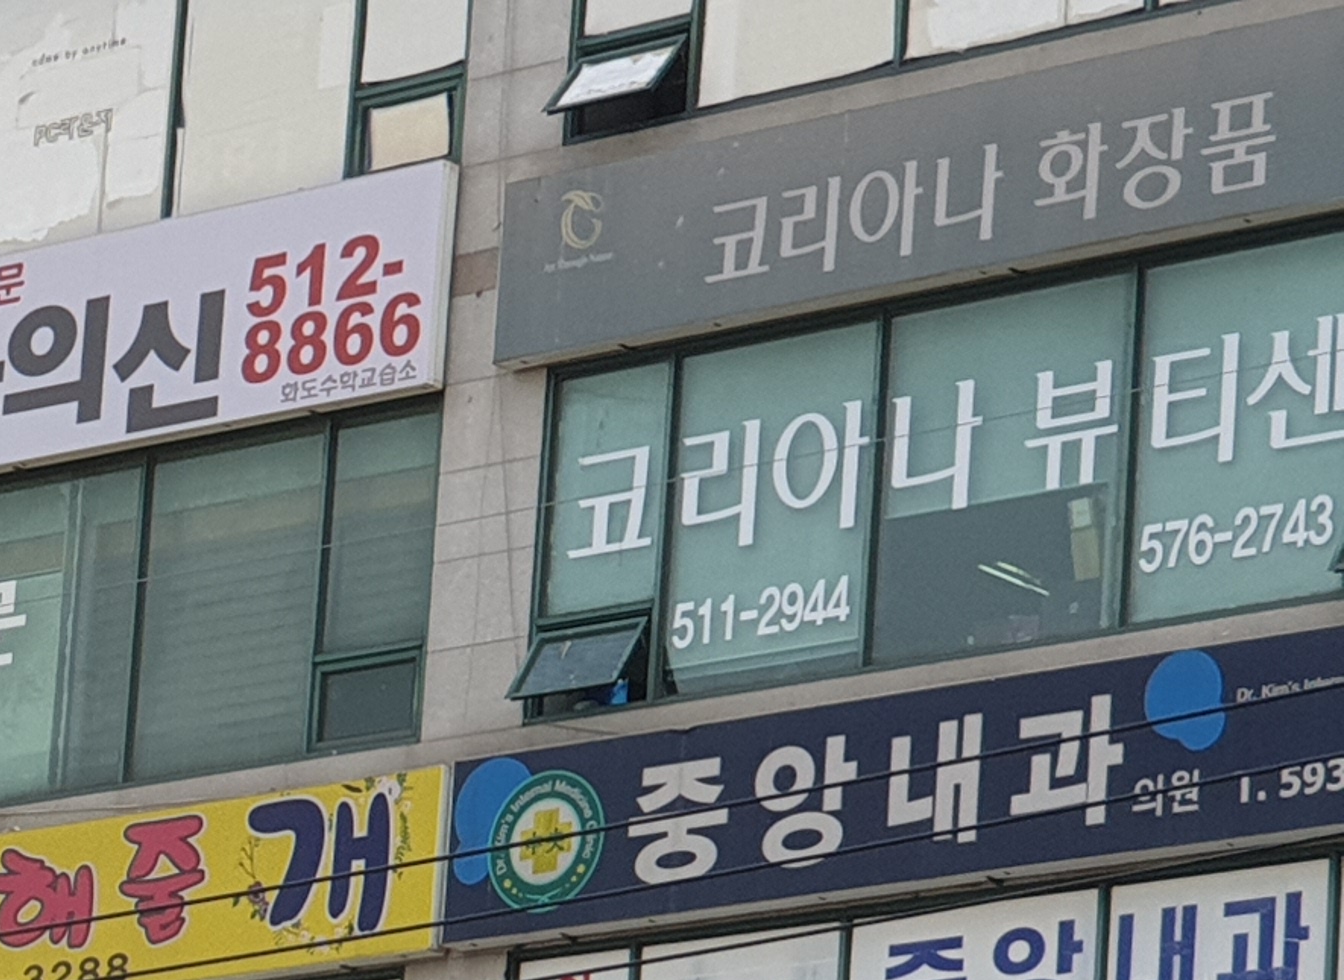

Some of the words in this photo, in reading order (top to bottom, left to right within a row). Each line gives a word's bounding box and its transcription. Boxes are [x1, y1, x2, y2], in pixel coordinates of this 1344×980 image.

[704, 143, 1004, 284] 코리아나
[1033, 91, 1277, 220] 화장품
[246, 234, 405, 318] 512-
[242, 292, 422, 384] 8866
[280, 360, 417, 405] 화도수학교습소
[567, 379, 983, 559] 코리아나
[1138, 494, 1334, 573] 576-2743
[672, 575, 849, 650] 511-2944
[627, 694, 1124, 886] 중앙내과
[1131, 768, 1201, 818] 의원
